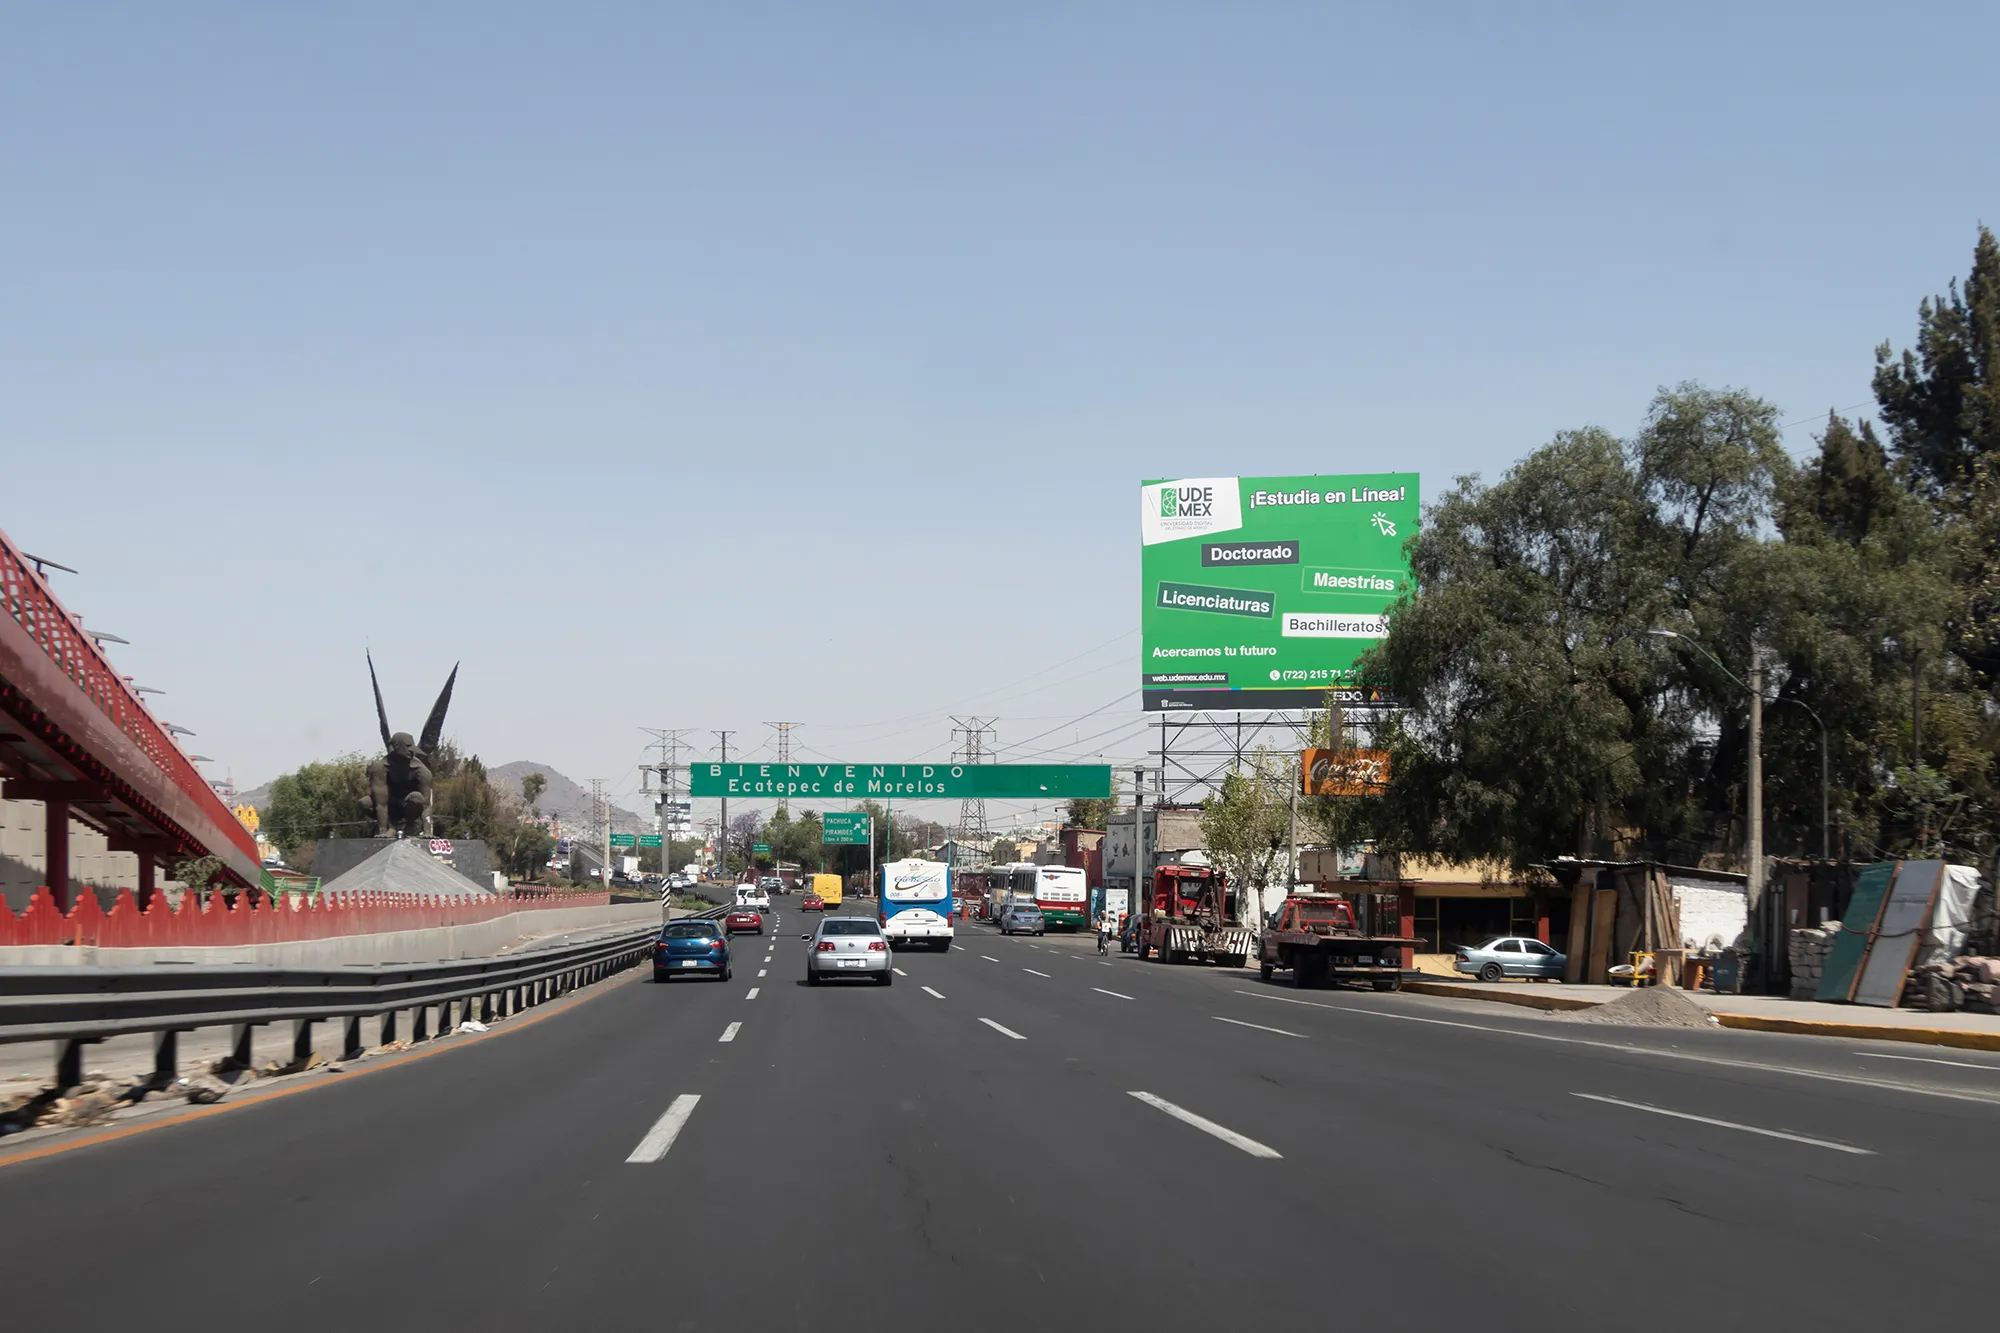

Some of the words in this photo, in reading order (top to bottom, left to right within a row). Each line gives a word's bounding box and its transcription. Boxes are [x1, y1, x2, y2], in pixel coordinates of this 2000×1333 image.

[1178, 487, 1213, 502] UDE
[1249, 489, 1320, 509] ¡Estudia
[1324, 490, 1346, 503] en
[1351, 486, 1405, 503] Línea!
[1178, 503, 1213, 517] MEX
[1211, 545, 1292, 561] Doctorado
[1313, 571, 1395, 591] Maestrías
[1162, 589, 1270, 613] Licenciaturas
[1289, 618, 1384, 633] Bachilleratos
[1152, 646, 1221, 657] Acercamos
[1224, 645, 1237, 656] tu
[1240, 645, 1277, 656] futuro
[1152, 673, 1226, 682] web.udemex.edu.mx
[1282, 669, 1308, 680] (722)
[1309, 669, 1328, 679] 215
[1330, 669, 1341, 679] 71
[710, 764, 964, 778] BIENVENIDO
[728, 779, 821, 796] Ecatepec
[833, 779, 855, 793] de
[867, 779, 946, 793] Morelos
